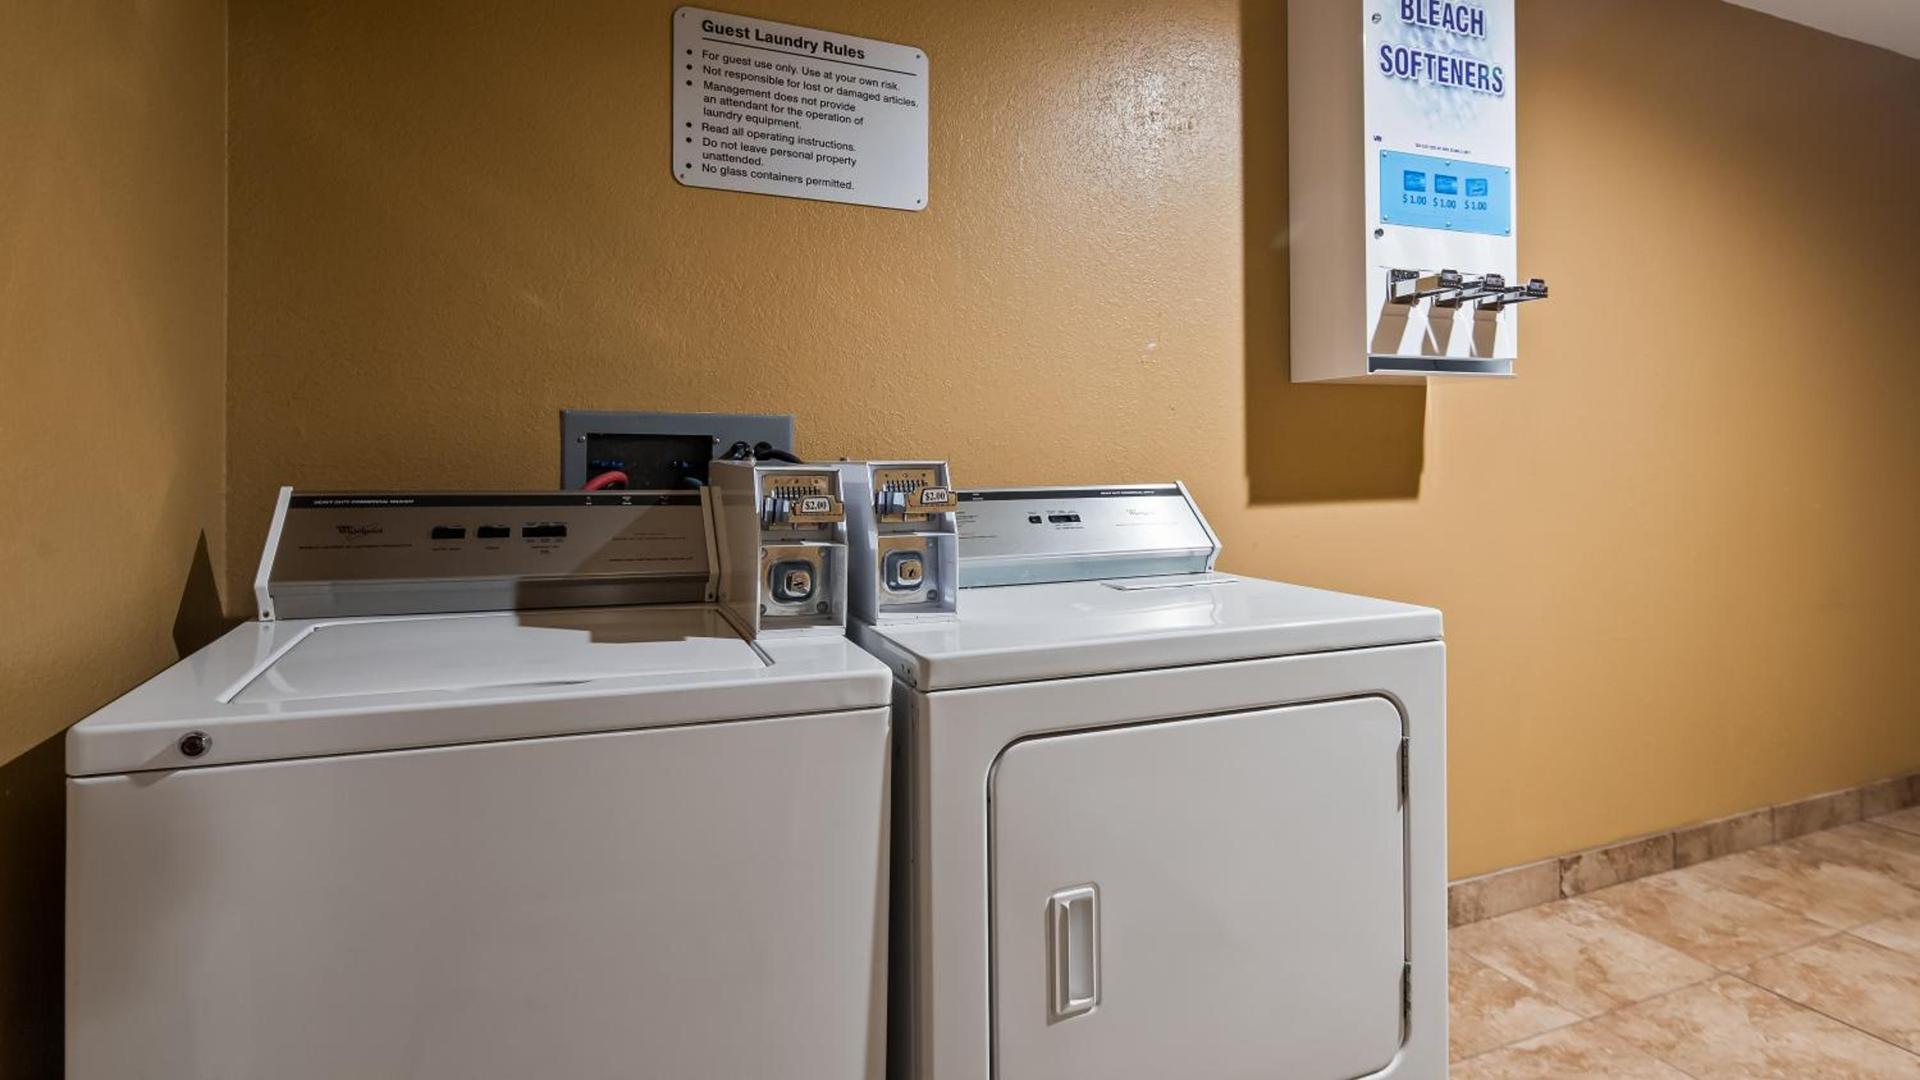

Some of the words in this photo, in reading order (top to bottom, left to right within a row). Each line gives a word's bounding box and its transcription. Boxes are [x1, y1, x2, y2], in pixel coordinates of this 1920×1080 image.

[1401, 0, 1484, 36] BLEACH
[702, 19, 750, 39] Guest
[755, 28, 818, 54] Laundry
[823, 41, 865, 60] Rules
[702, 49, 719, 61] For
[722, 55, 751, 66] guest
[754, 60, 773, 70] use
[775, 63, 798, 75] only.
[802, 66, 821, 77] Use
[823, 70, 833, 80] at
[835, 73, 856, 83] your
[859, 78, 879, 87] own
[881, 80, 899, 91] risk.
[703, 65, 721, 76] Not
[724, 69, 784, 87] responsible
[787, 79, 800, 88] for
[803, 81, 821, 92] lost
[823, 84, 834, 93] or
[836, 86, 880, 101] damaged
[1380, 44, 1504, 93] SOFTENERS
[703, 80, 771, 99] Management
[774, 91, 798, 103] does
[801, 95, 817, 105] not
[820, 99, 856, 112] provide
[703, 95, 717, 104] an
[719, 97, 768, 112] attendant
[771, 104, 784, 113] for
[787, 106, 803, 117] the
[805, 110, 851, 123] operation
[854, 117, 864, 125] of
[703, 107, 743, 122] laundry
[745, 114, 801, 129] equipment.
[702, 122, 729, 135] Read
[731, 127, 744, 136] all
[747, 131, 795, 145] operating
[797, 135, 856, 152] instructions.
[702, 137, 718, 147] Do
[720, 141, 737, 150] not
[740, 142, 767, 154] leave
[770, 147, 814, 161] personal
[816, 153, 857, 168] property
[702, 151, 763, 167] unattended.
[702, 163, 717, 173] No
[720, 166, 748, 177] glass
[750, 170, 803, 184] containers
[805, 176, 854, 190] permitted.
[804, 500, 827, 510] $2.00
[924, 490, 946, 501] $2.00
